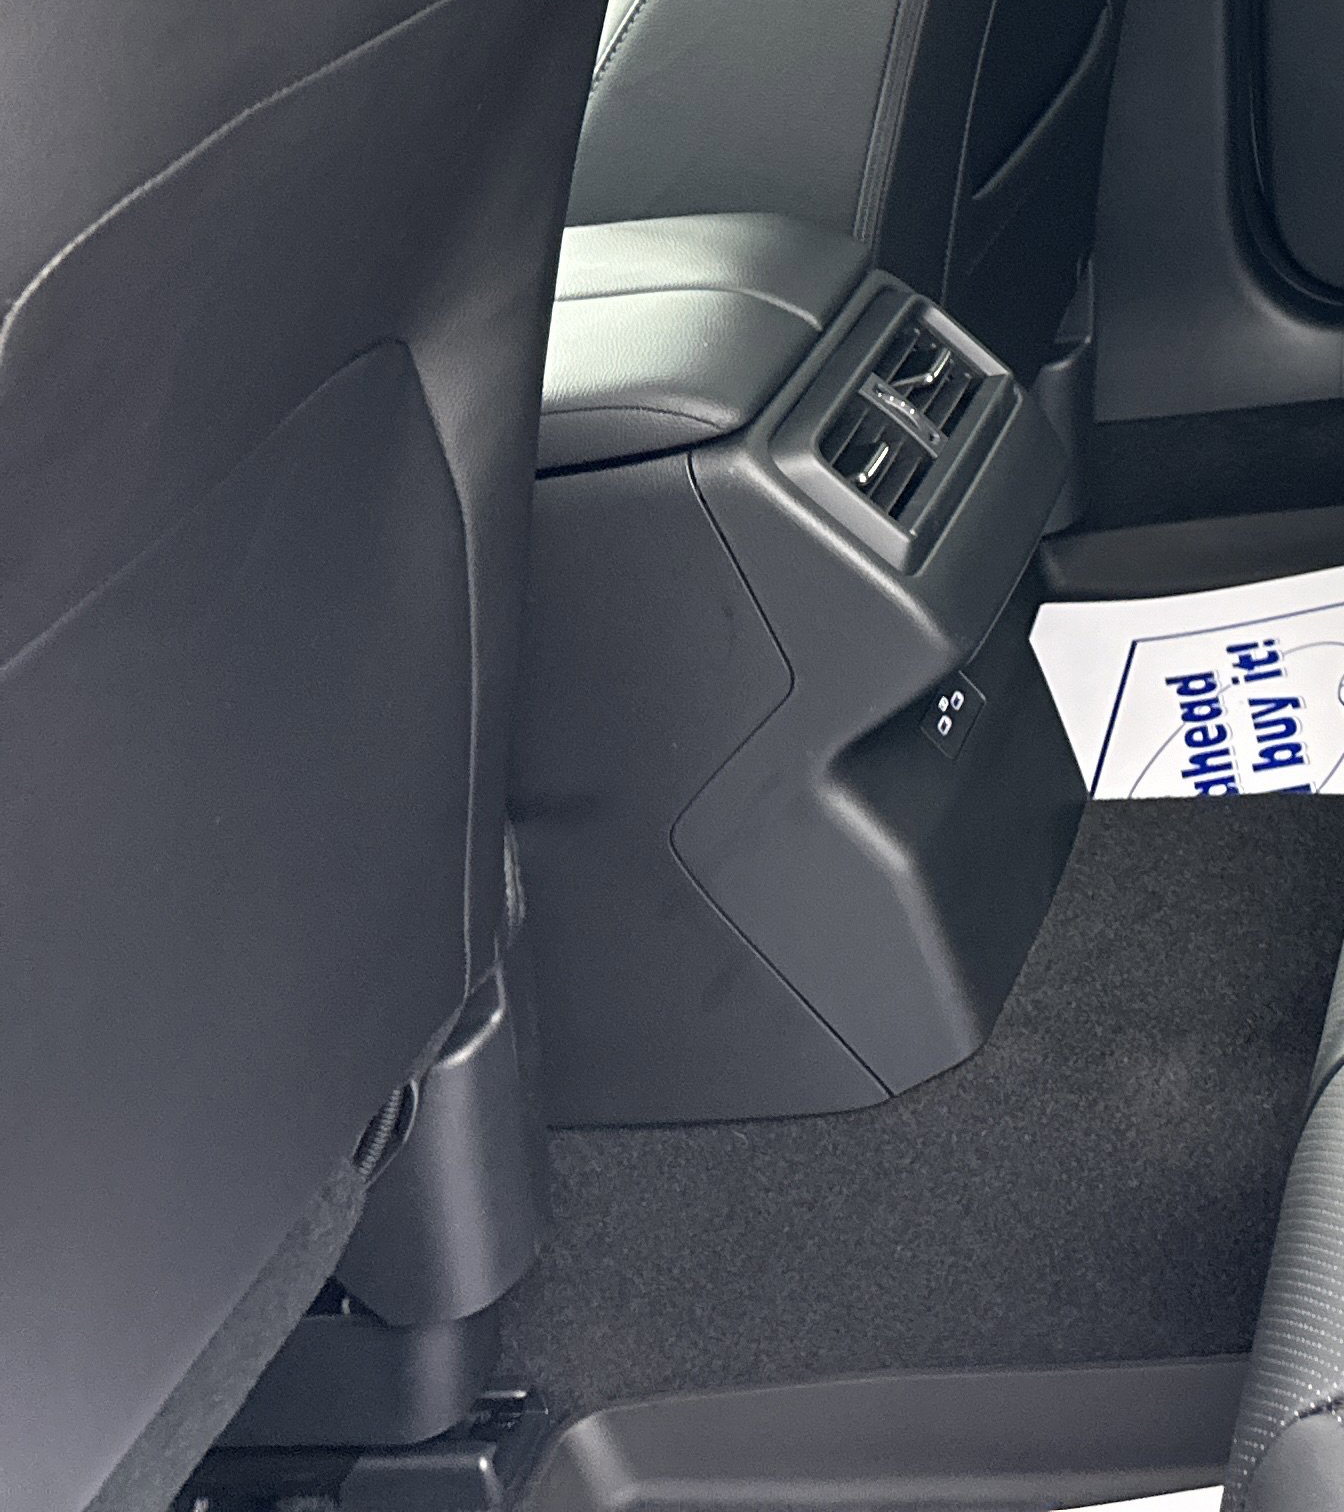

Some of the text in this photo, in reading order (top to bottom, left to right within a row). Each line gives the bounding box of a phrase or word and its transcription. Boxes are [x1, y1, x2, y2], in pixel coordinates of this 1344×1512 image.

[1226, 639, 1284, 685] it!
[1165, 671, 1240, 798] ahead
[1248, 696, 1305, 772] buy
